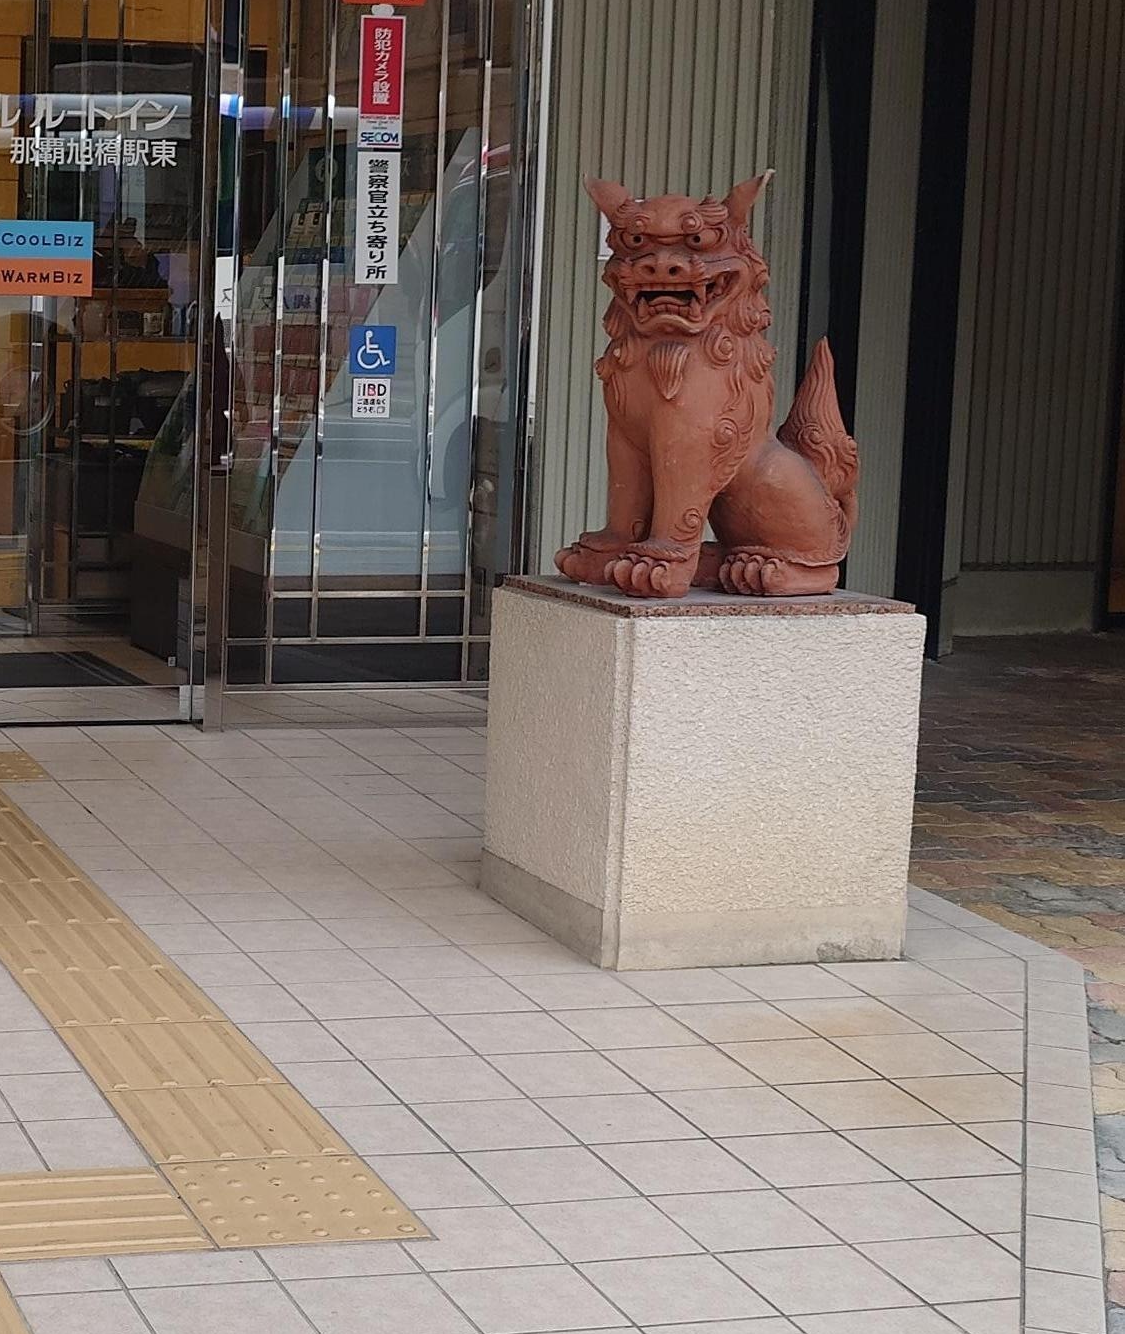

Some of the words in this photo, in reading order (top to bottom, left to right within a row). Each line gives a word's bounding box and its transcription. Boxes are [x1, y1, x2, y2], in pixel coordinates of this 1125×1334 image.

[373, 27, 393, 105] 防犯カメラ設置
[29, 94, 178, 132] ルートイン
[9, 136, 178, 167] 那覇旭橋駅東
[360, 131, 400, 143] SECOM
[365, 158, 390, 280] 警察官立ち寄り所
[363, 383, 387, 397] IBD
